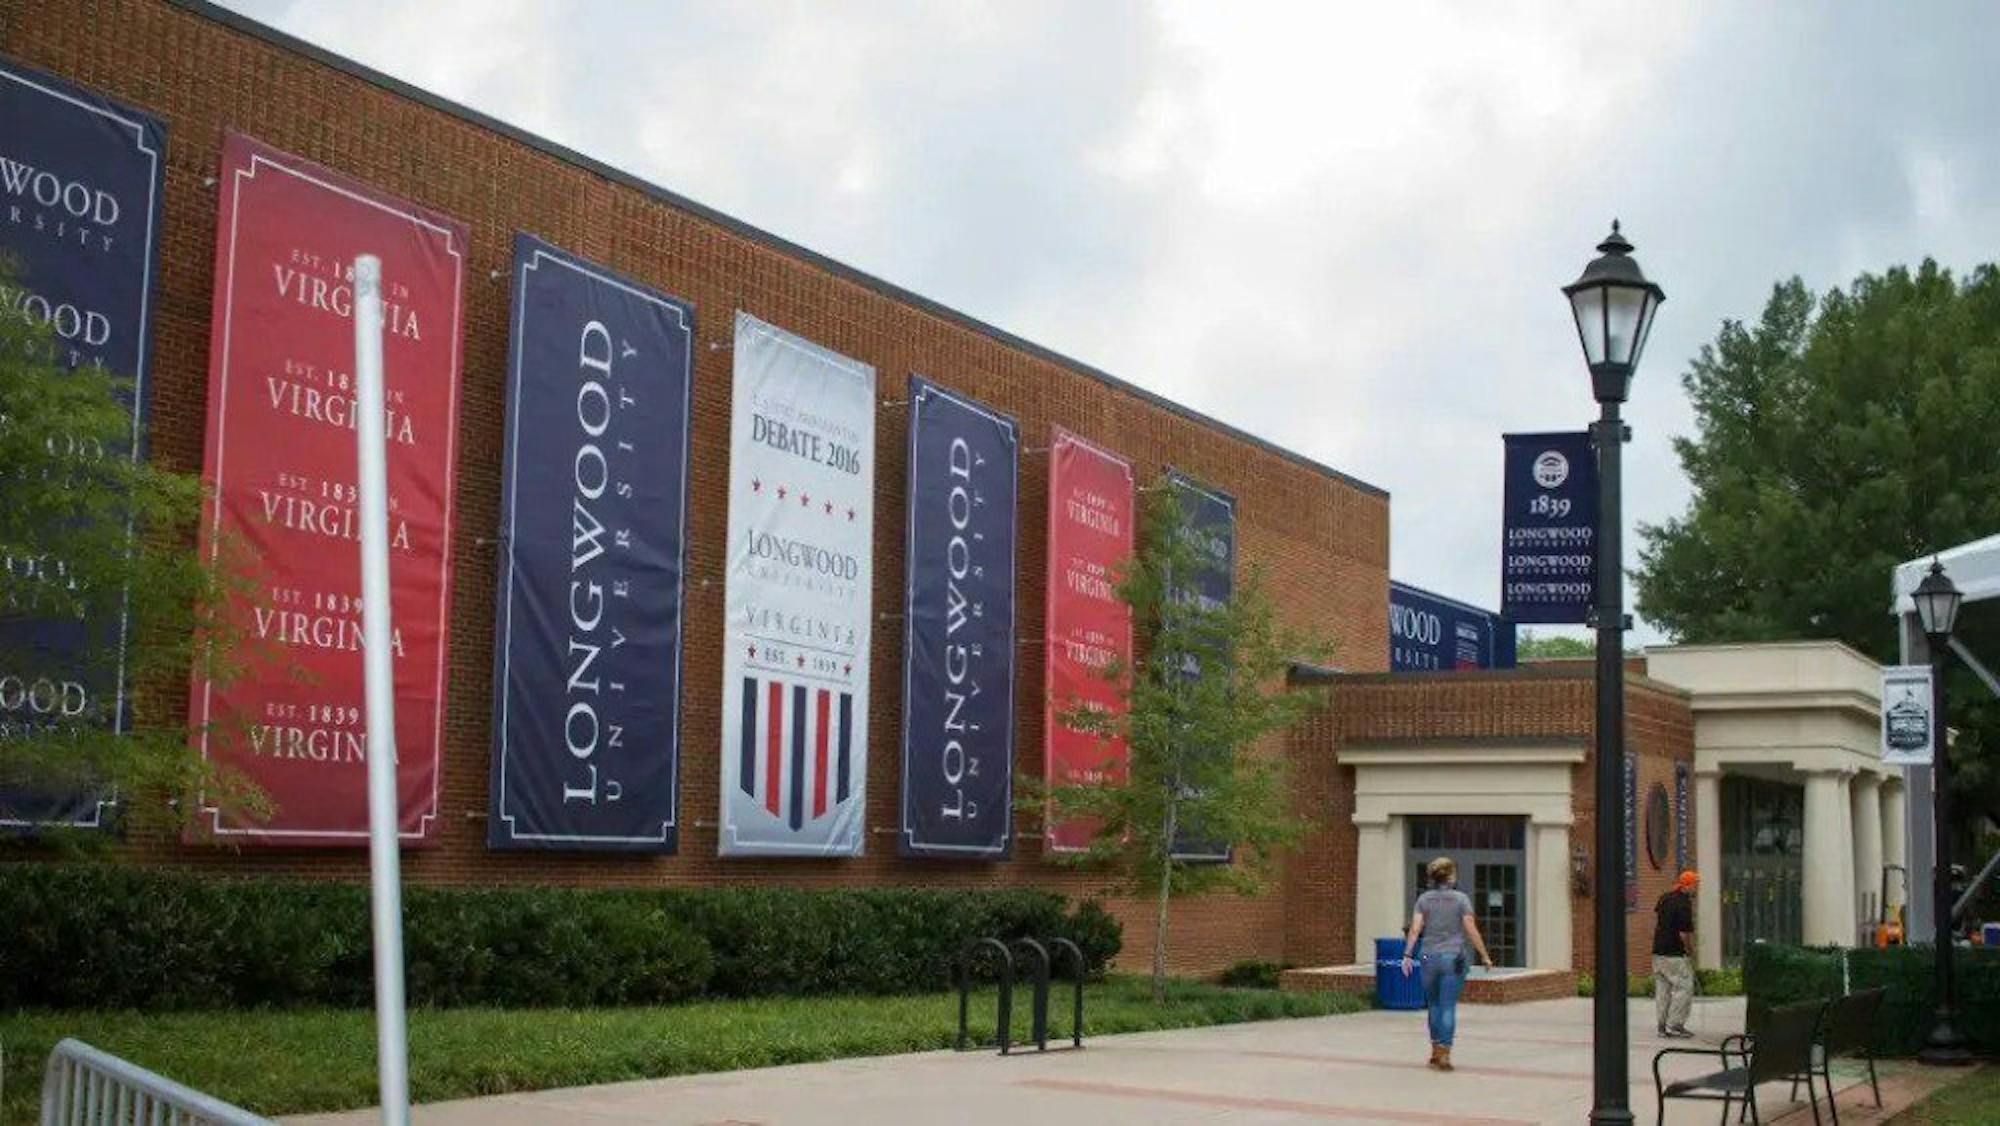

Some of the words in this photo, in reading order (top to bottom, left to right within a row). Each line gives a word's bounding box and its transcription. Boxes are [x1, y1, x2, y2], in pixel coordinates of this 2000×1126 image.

[274, 263, 421, 341] VIRGIA
[267, 376, 416, 444] VIRGIIA
[752, 413, 822, 463] DEBATE
[826, 441, 860, 475] 2016
[321, 481, 358, 503] 183
[1529, 494, 1572, 518] 1839
[259, 490, 410, 550] VIRGIA
[1508, 527, 1593, 539] LONGWOOD
[563, 320, 613, 806] LONGWOOD
[606, 338, 638, 801] UNIVERSITY
[748, 529, 858, 580] LONGWOOD
[1508, 555, 1592, 567] LONGWOOD
[1507, 583, 1592, 595] LONGWOOD
[254, 606, 406, 658] VIRGINA
[941, 436, 971, 820] LONGWOOD
[967, 451, 986, 819] UNIVERSITY
[308, 703, 360, 726] 1839
[250, 724, 399, 765] VIRGIN
